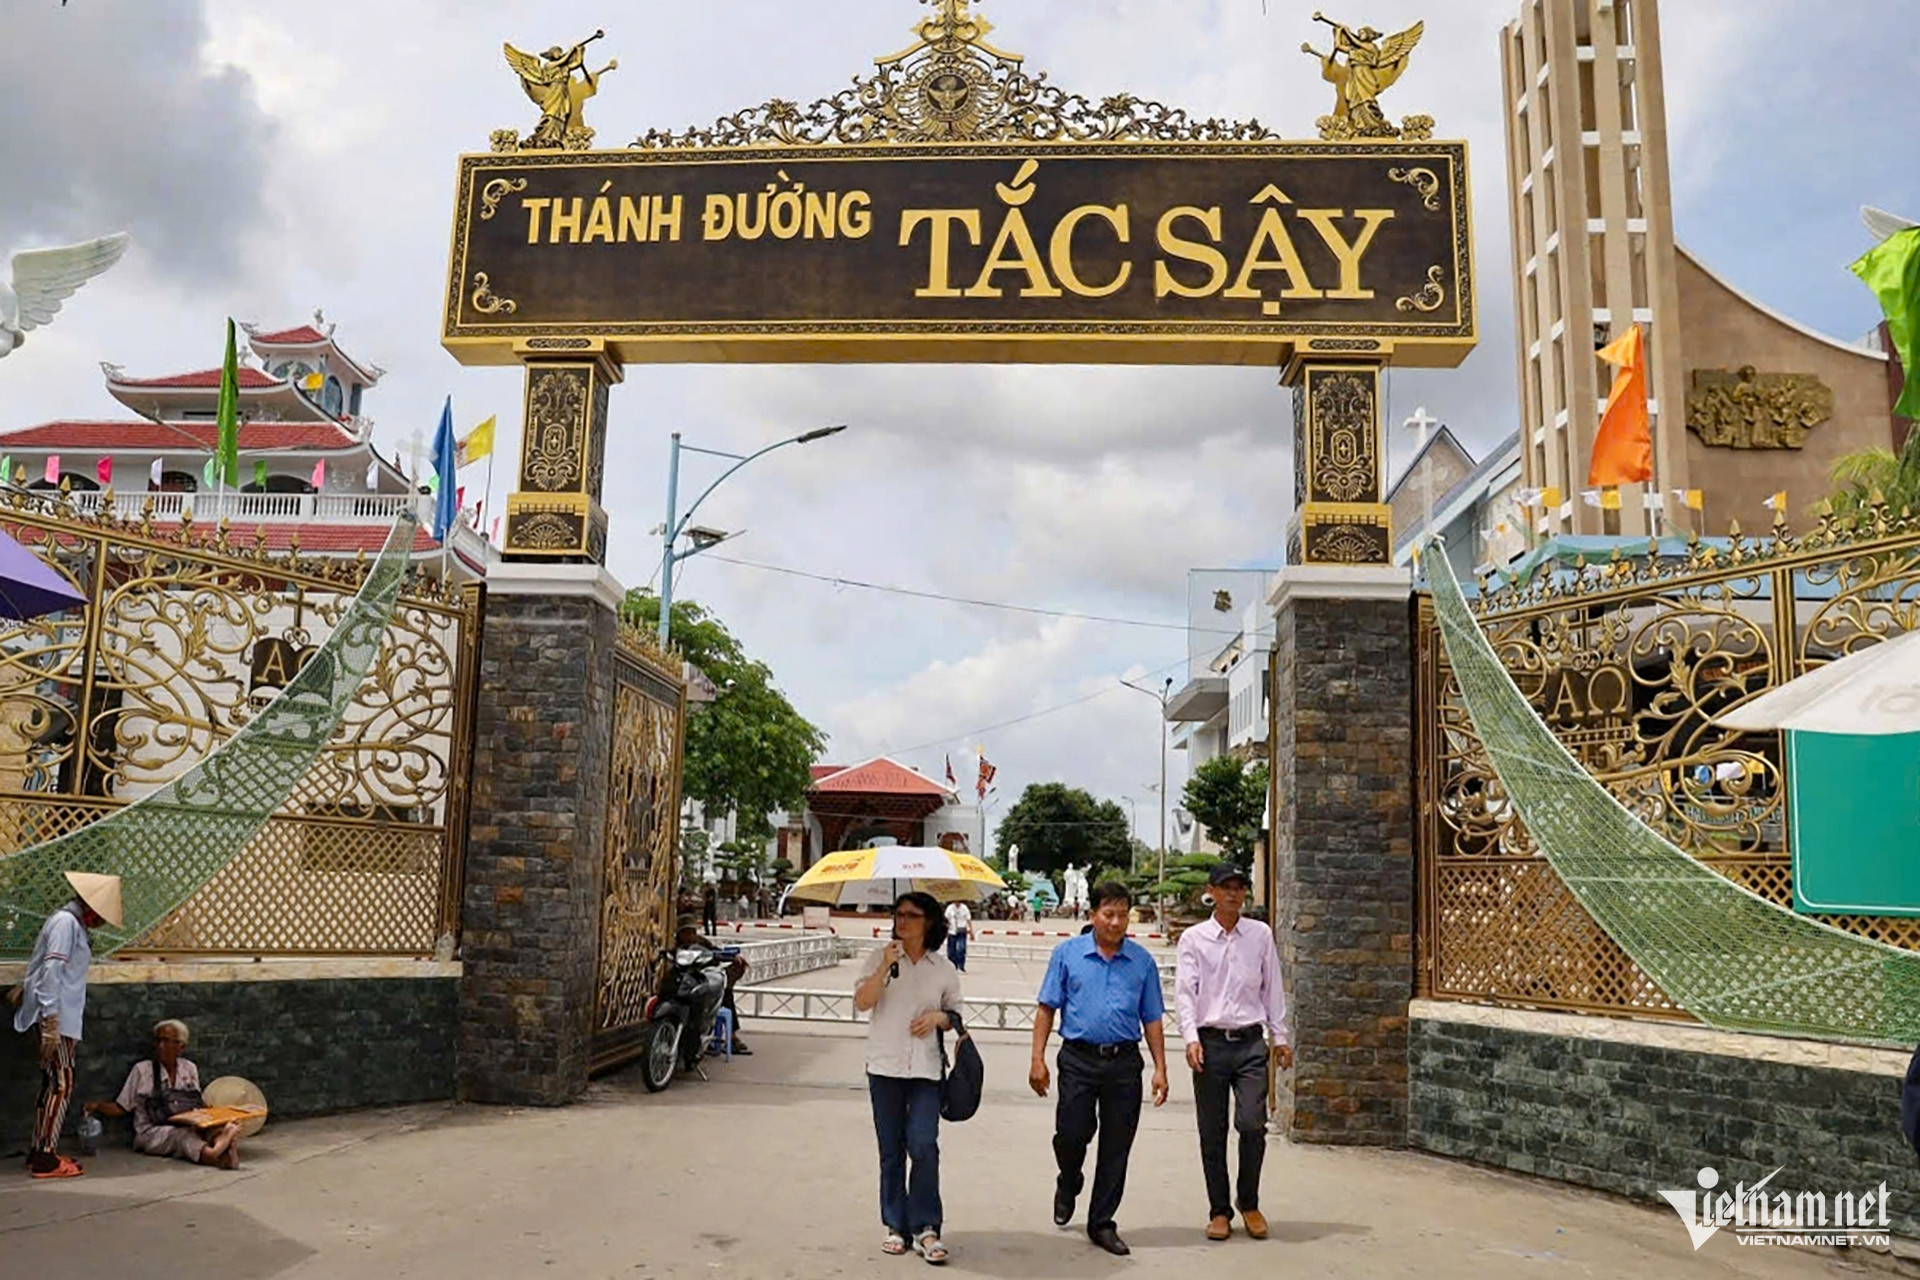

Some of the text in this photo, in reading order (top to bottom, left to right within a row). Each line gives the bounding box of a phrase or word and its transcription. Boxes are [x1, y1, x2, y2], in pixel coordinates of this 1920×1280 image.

[522, 160, 1395, 315] THÁNH ĐƯỜNG TẮC SẬY
